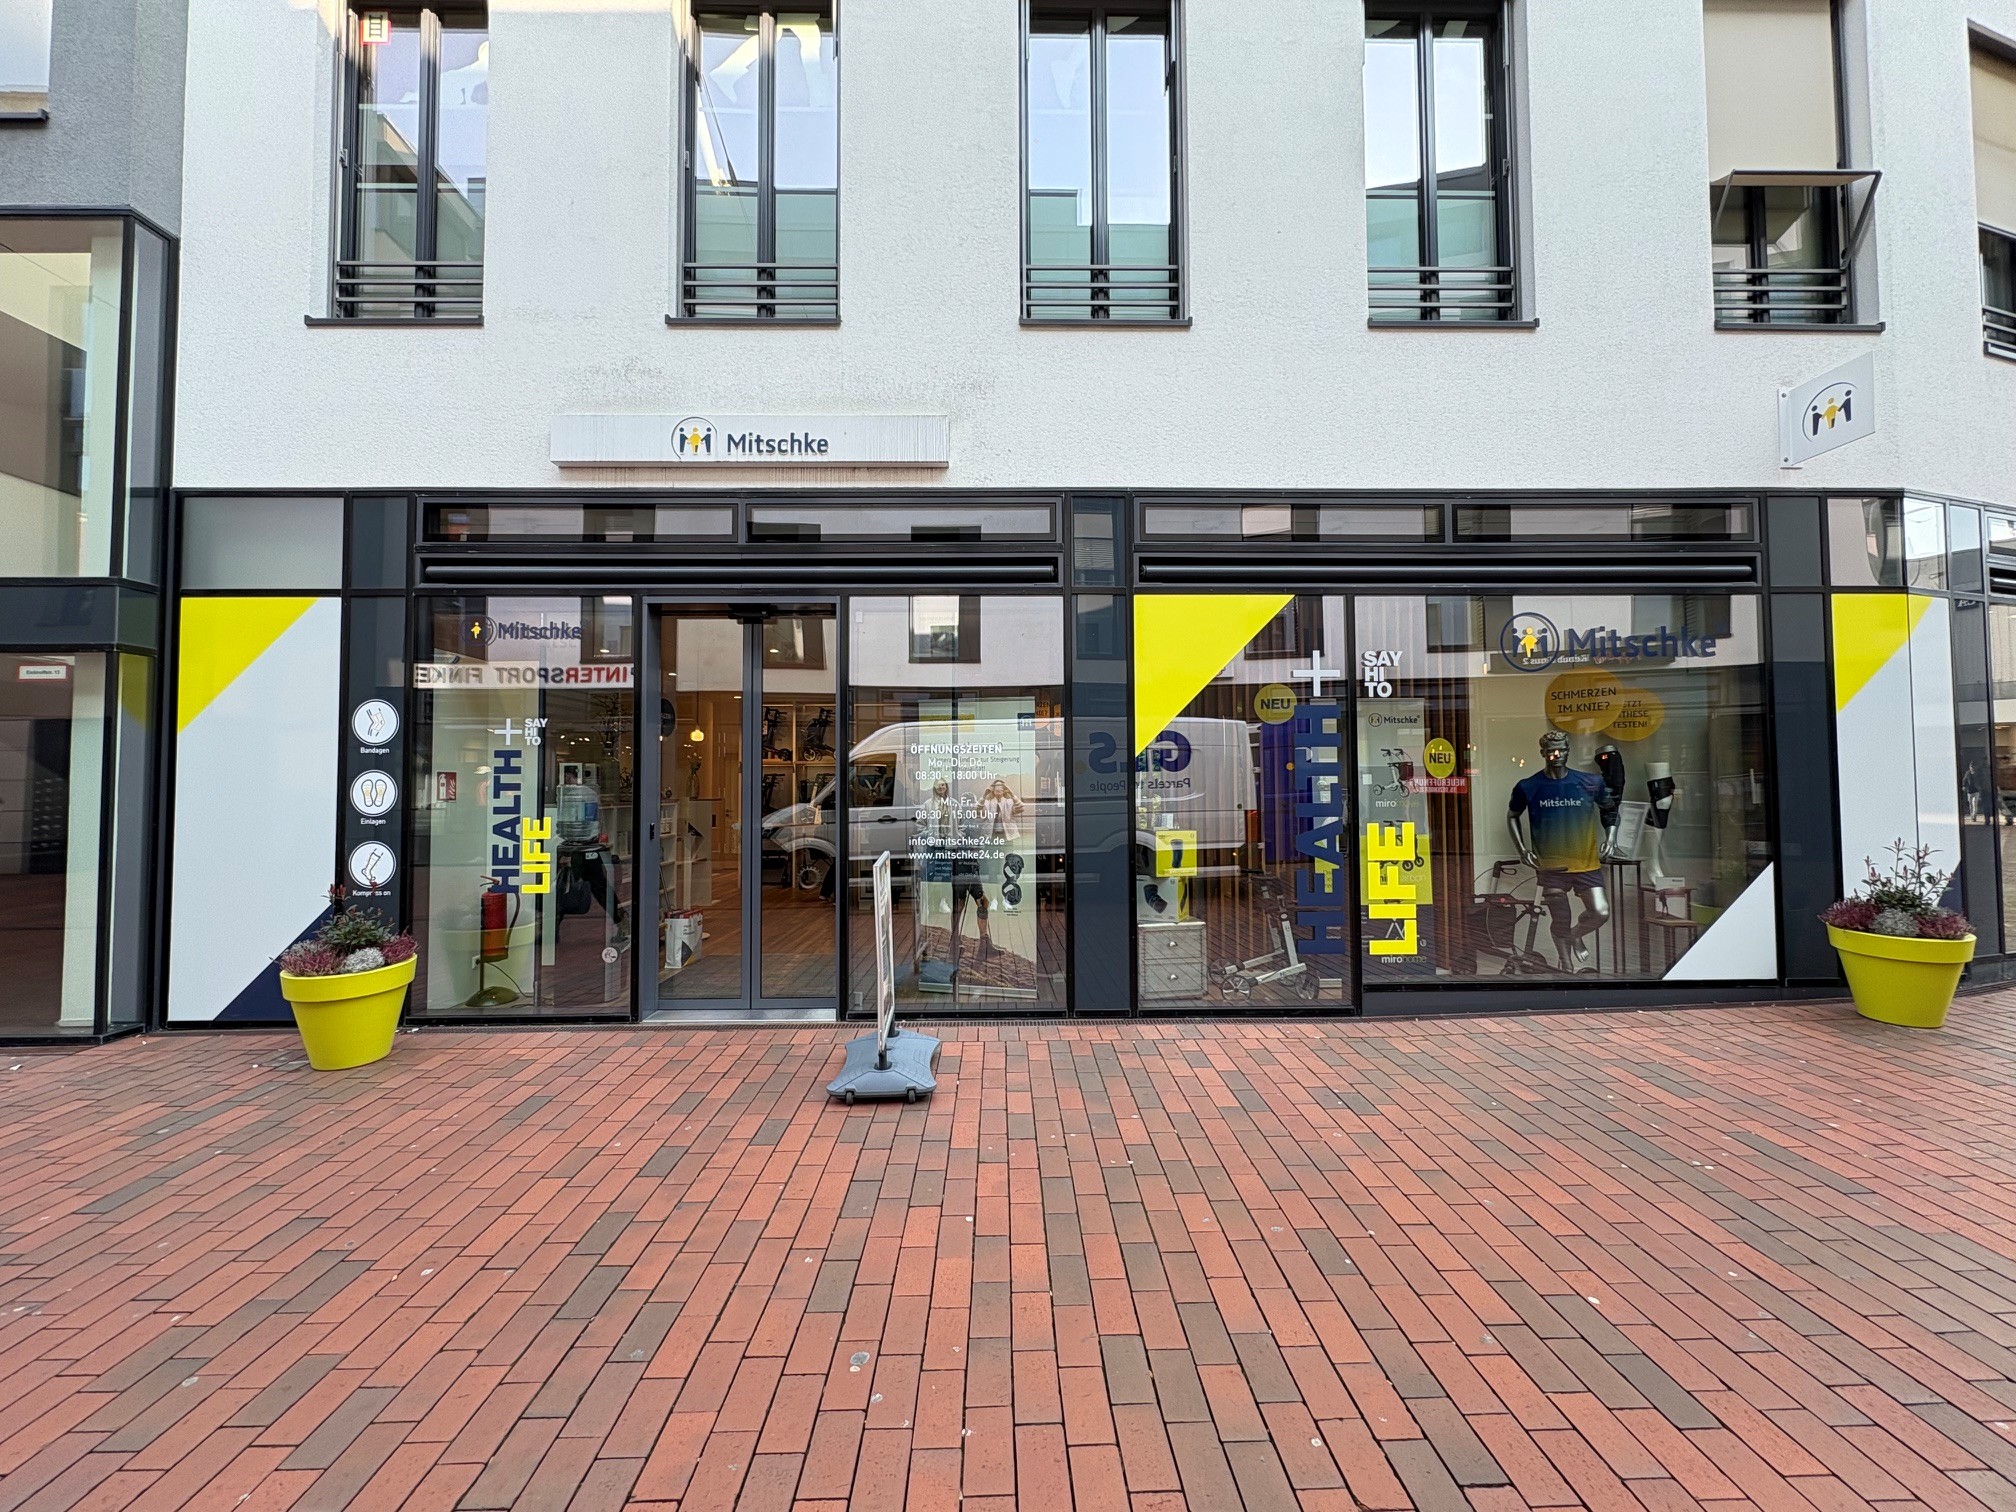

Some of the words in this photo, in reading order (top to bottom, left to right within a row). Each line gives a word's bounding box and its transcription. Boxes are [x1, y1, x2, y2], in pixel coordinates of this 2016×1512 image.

[726, 431, 830, 456] Mitschke
[497, 621, 582, 641] Mitschke
[1567, 626, 1716, 658] Mitschke
[1363, 650, 1403, 667] SAY
[1364, 667, 1385, 682] HI
[1364, 682, 1393, 698] TO
[1550, 687, 1617, 701] SCHMERZEN
[1260, 698, 1292, 710] NEU
[1557, 703, 1576, 714] IM
[1576, 701, 1610, 713] KNIE?
[524, 718, 549, 728] SAY
[1383, 715, 1418, 724] Mitschke
[524, 727, 539, 737] HI
[524, 736, 542, 746] TO
[359, 746, 390, 755] Bandagen
[910, 742, 1002, 755] ÖFFNUNGSZEITEN
[969, 758, 985, 767] Do.
[1428, 752, 1452, 764] NEU
[915, 771, 942, 780] 08:30
[952, 771, 977, 780] 18:00
[979, 771, 998, 780] Uhr
[960, 797, 973, 806] Fr.
[1538, 797, 1582, 808] Mitschke
[915, 810, 942, 820] 08:30
[952, 810, 978, 820] 15:00
[979, 810, 999, 820] Uhr
[360, 818, 386, 826] Einlagen
[491, 749, 523, 894] HEALTH
[1293, 704, 1346, 955] HEALTH
[908, 836, 1006, 847] info@mitschke24.de
[521, 816, 552, 894] LIFE
[908, 849, 1006, 860] www.mitschke24.de
[1366, 821, 1419, 956] LIFE
